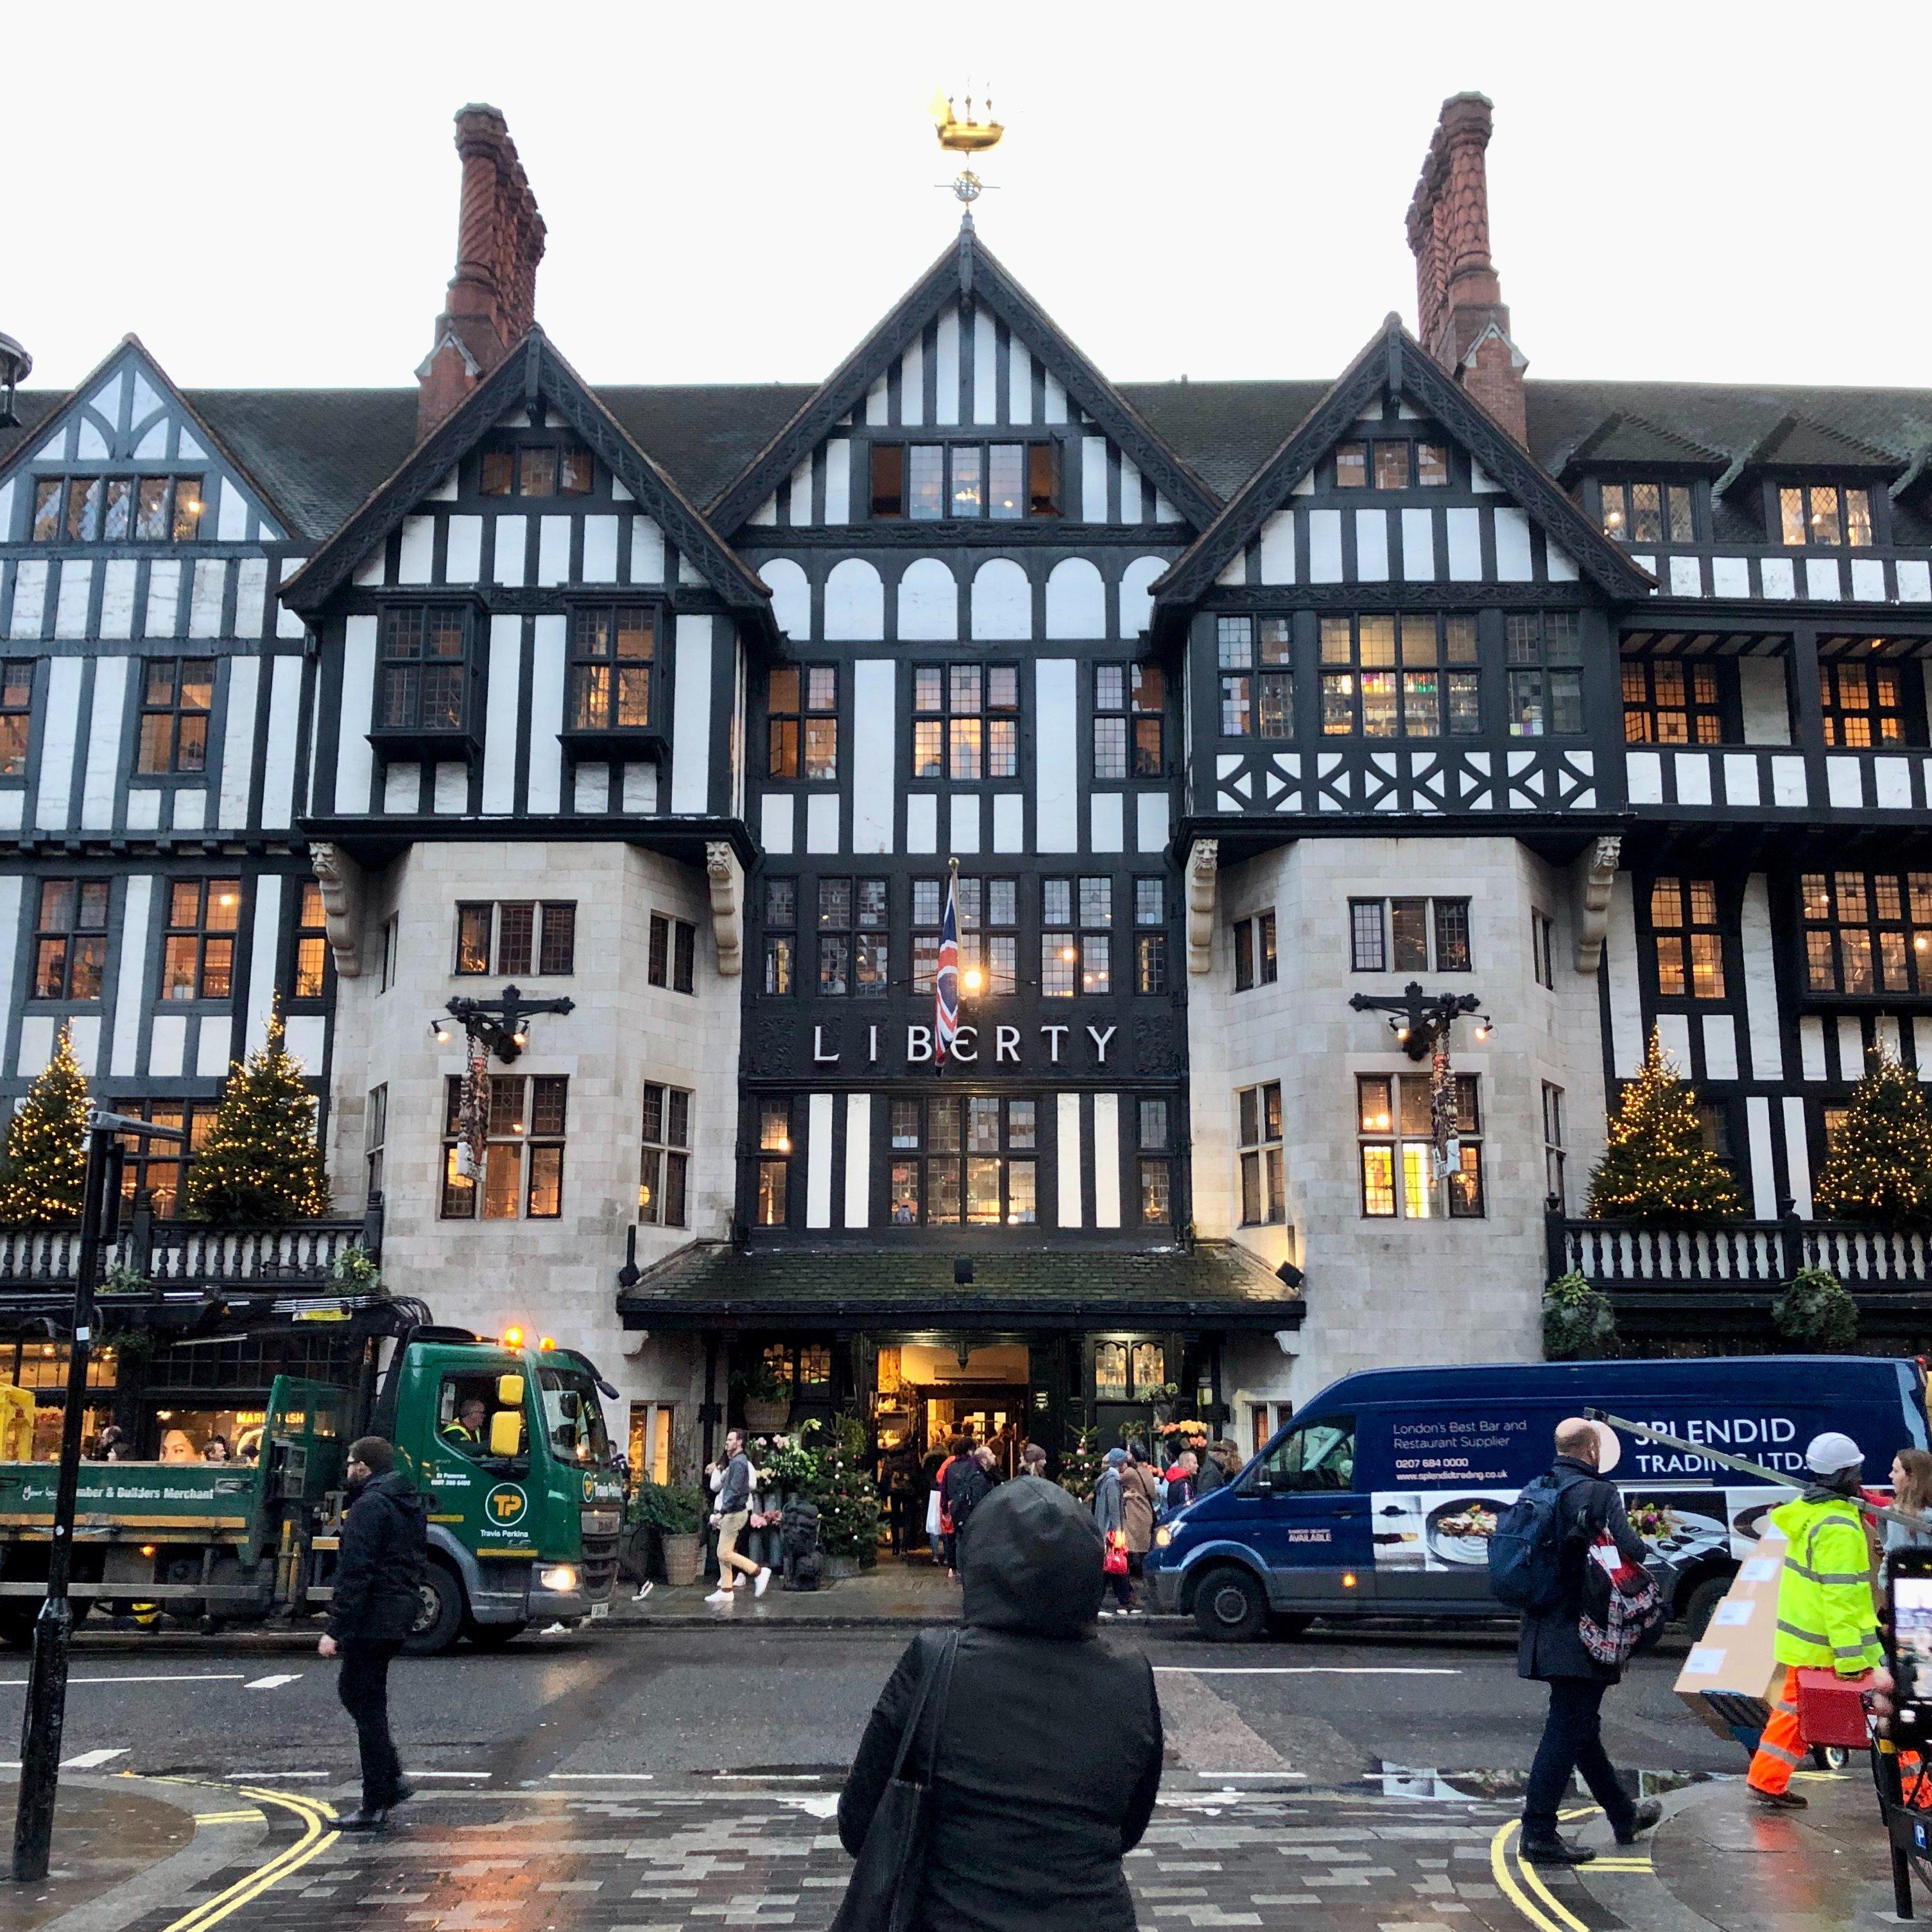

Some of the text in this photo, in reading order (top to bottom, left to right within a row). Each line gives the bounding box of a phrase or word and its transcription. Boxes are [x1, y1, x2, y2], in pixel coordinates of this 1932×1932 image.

[814, 1026, 1117, 1062] LIBERTY
[1393, 1420, 1527, 1434] London's Best Bar and
[1393, 1436, 1510, 1449] Restaurant Supplier
[163, 1487, 214, 1500] Merchant
[494, 1495, 522, 1516] TP
